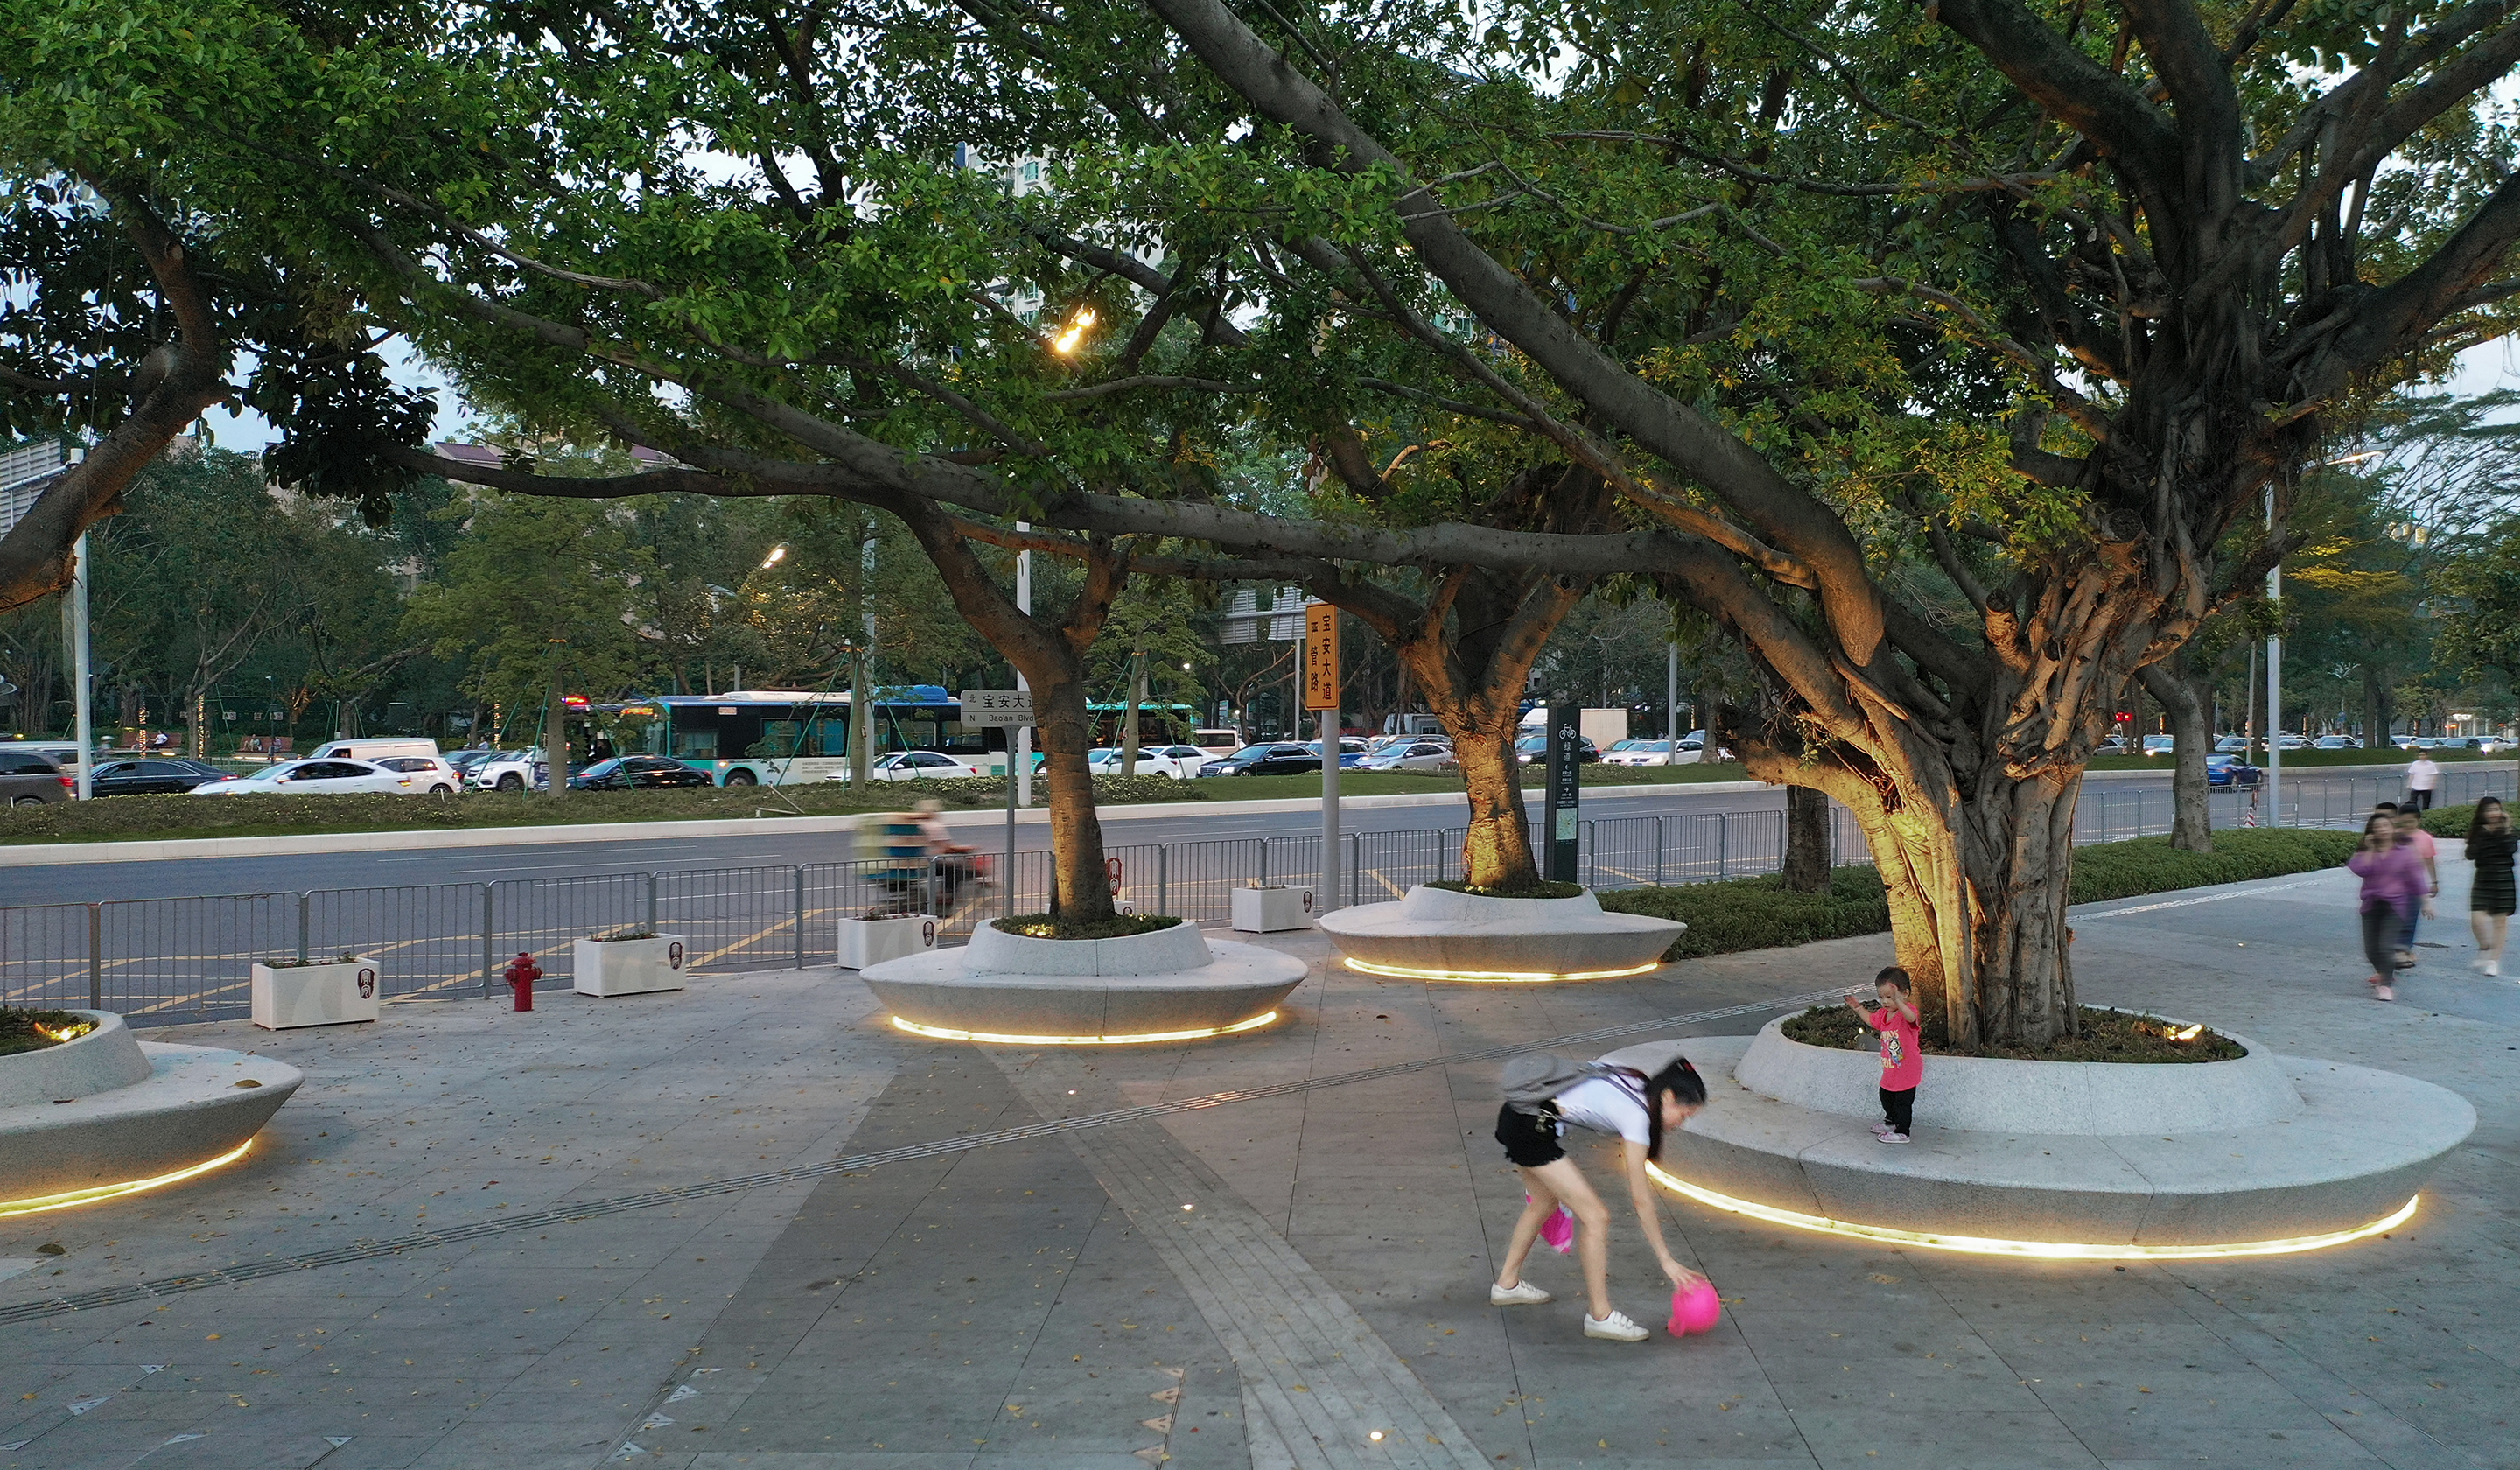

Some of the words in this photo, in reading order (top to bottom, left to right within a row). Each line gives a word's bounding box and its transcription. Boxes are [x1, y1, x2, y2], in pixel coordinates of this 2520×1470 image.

[1322, 613, 1332, 699] 宝安大道
[969, 694, 976, 703] 北
